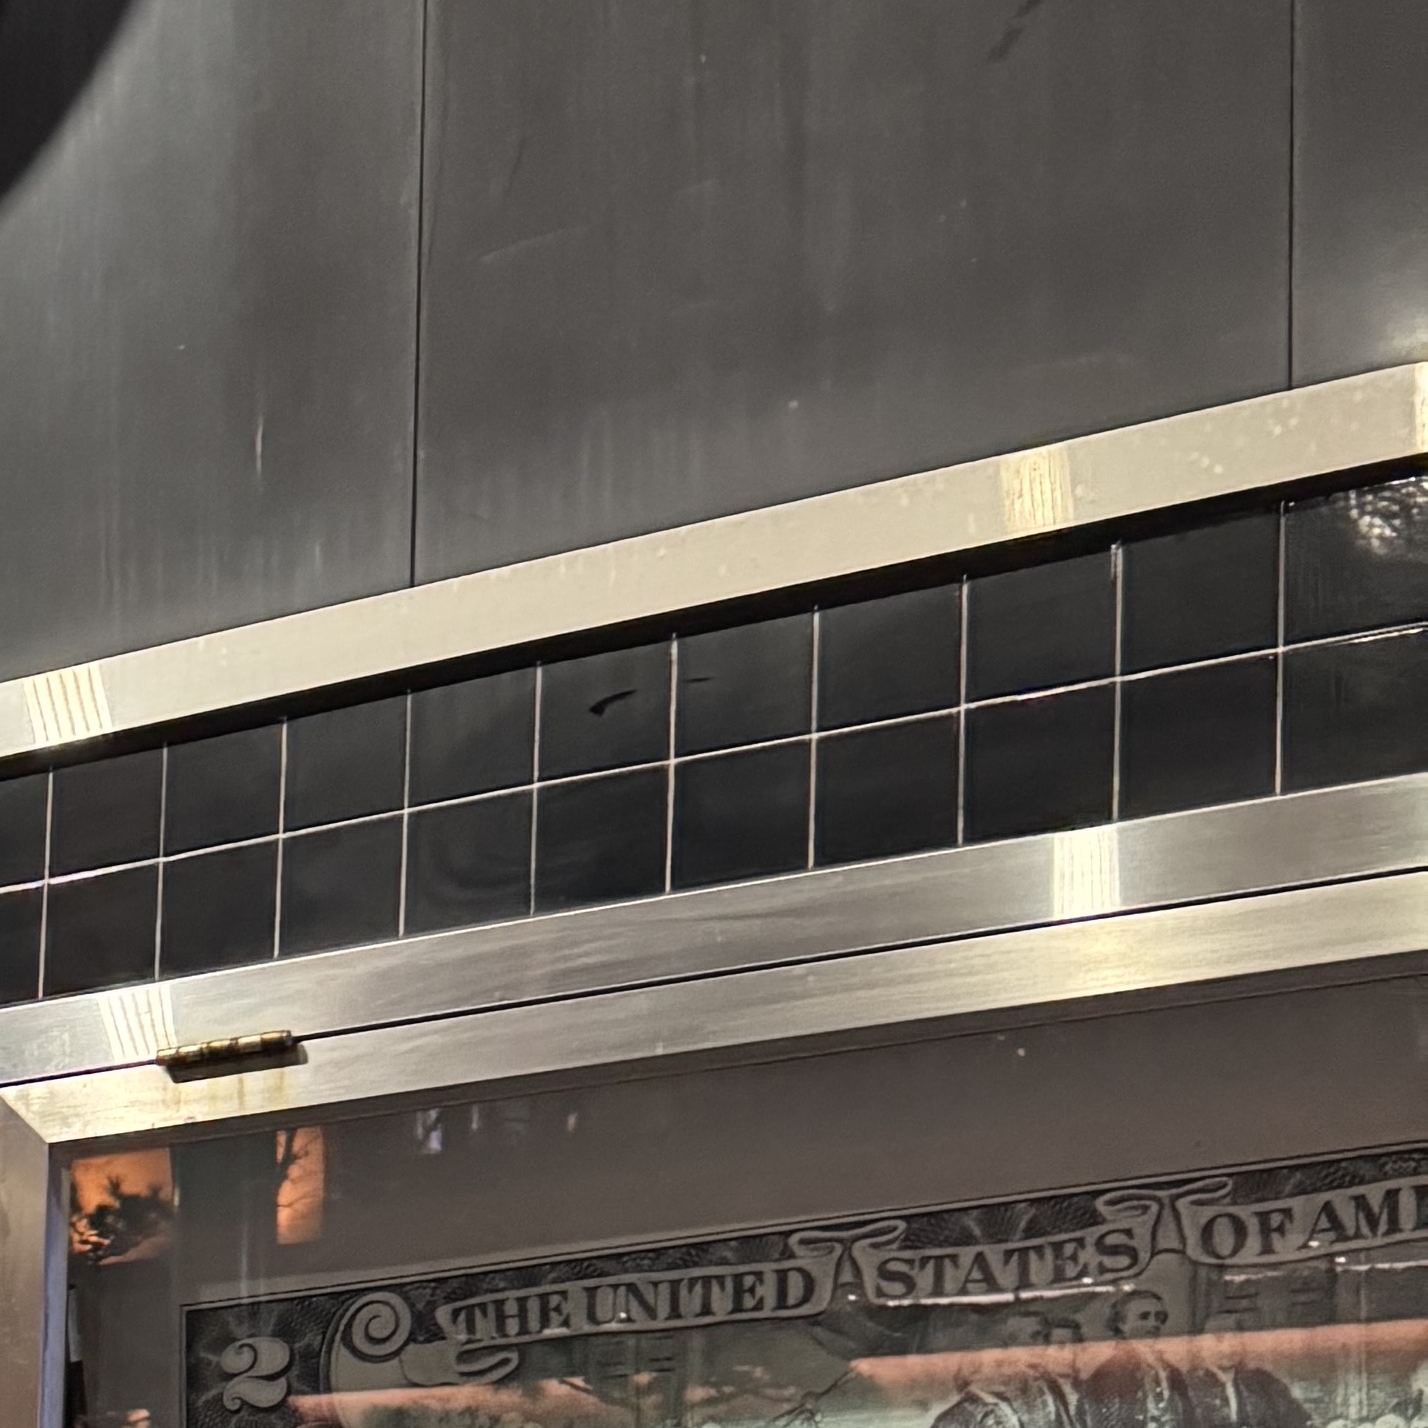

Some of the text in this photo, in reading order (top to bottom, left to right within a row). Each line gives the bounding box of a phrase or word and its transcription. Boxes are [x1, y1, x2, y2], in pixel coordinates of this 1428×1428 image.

[451, 1289, 572, 1343] THE
[582, 1266, 817, 1327] UNITED
[875, 1227, 1140, 1300] STATES
[1200, 1206, 1295, 1260] OF
[220, 1336, 293, 1413] 2
